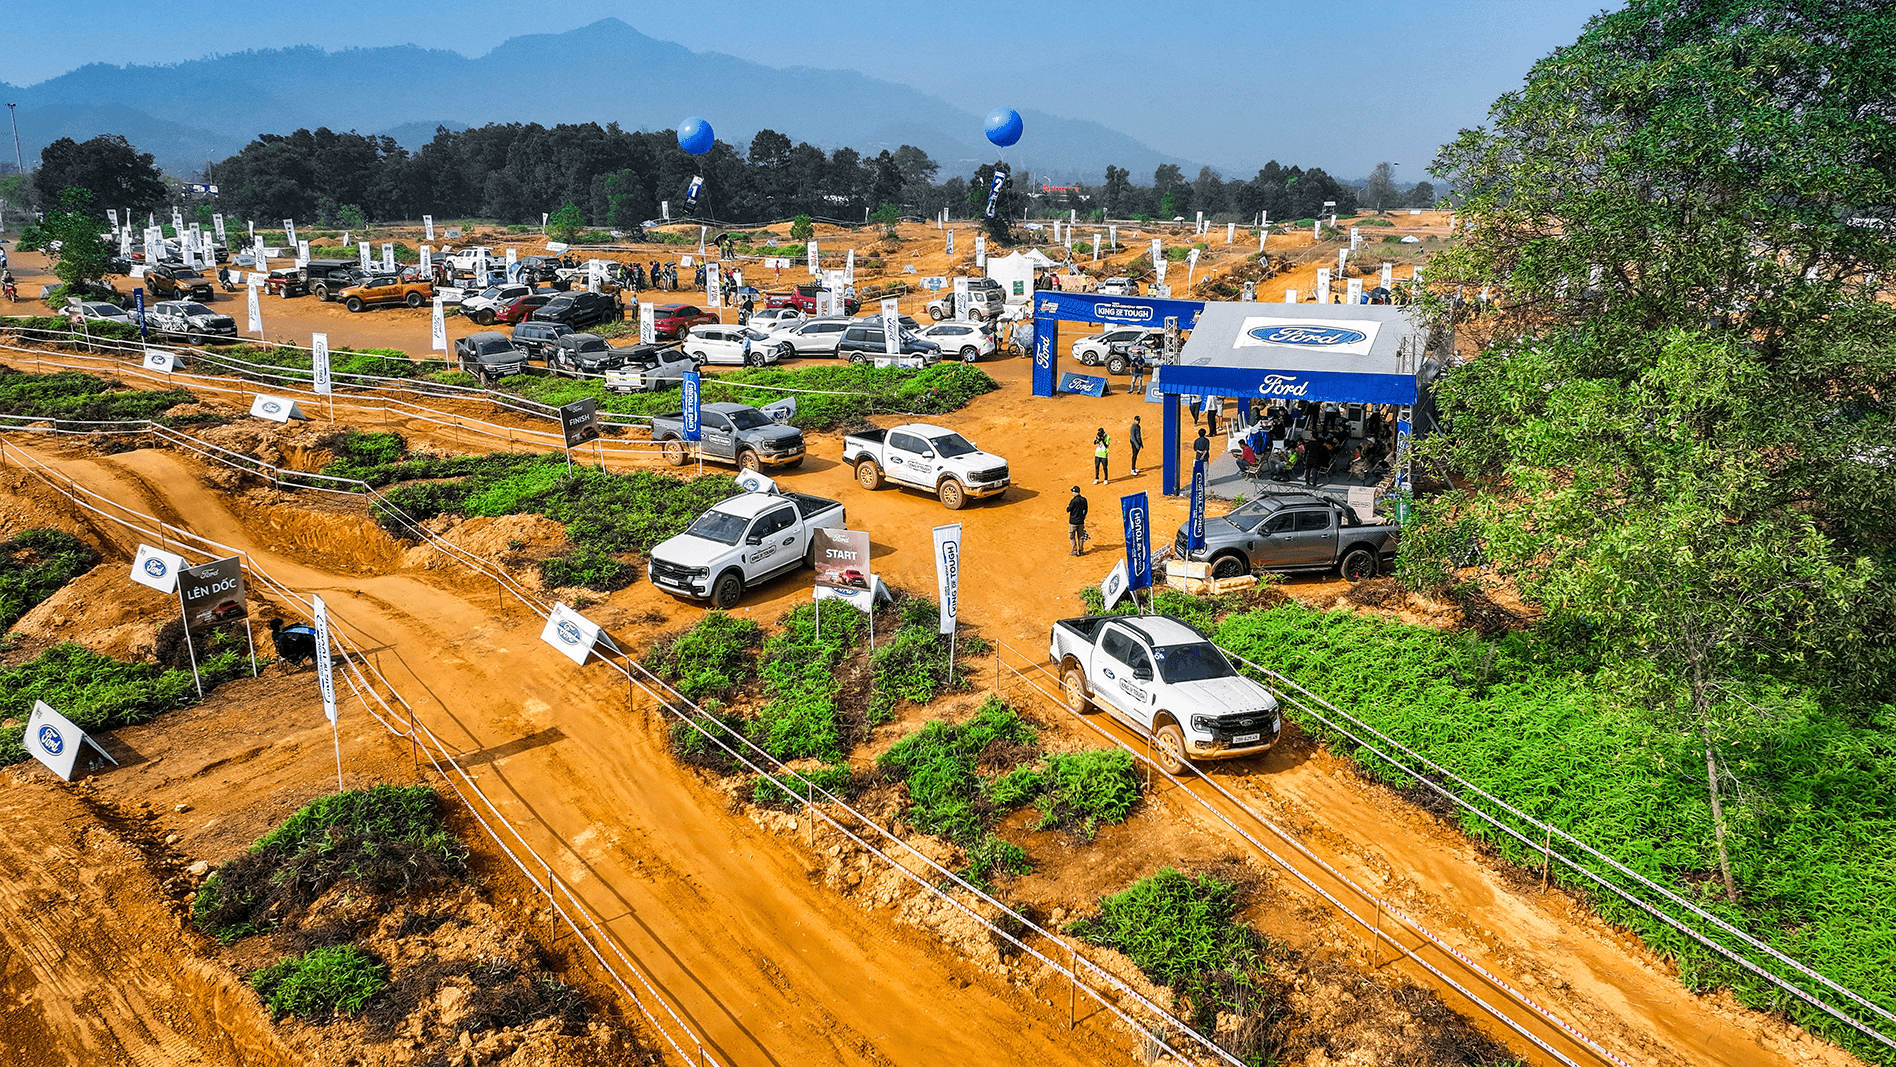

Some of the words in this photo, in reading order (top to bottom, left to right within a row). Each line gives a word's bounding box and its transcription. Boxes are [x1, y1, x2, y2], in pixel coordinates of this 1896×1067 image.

[691, 185, 698, 198] 1
[993, 178, 1003, 193] 2
[1098, 307, 1115, 316] KING
[1115, 308, 1124, 316] OF
[1124, 309, 1149, 318] TOUGH
[642, 320, 652, 345] Ford
[887, 317, 896, 342] Ford
[1270, 326, 1340, 345] Ford
[1036, 334, 1050, 369] Ford
[1068, 377, 1095, 392] Ford
[1259, 374, 1309, 397] Ford
[569, 413, 590, 426] FINISH
[1134, 512, 1142, 543] TOUGH
[832, 533, 850, 543] Ford
[826, 548, 858, 560] START
[144, 558, 165, 576] Ford
[947, 546, 957, 579] TOUGH
[200, 568, 219, 580] Ford
[187, 585, 209, 600] LÊN
[212, 576, 237, 594] DỐC
[951, 580, 957, 589] OF
[1133, 688, 1145, 700] TOUGH
[41, 728, 61, 752] Ford
